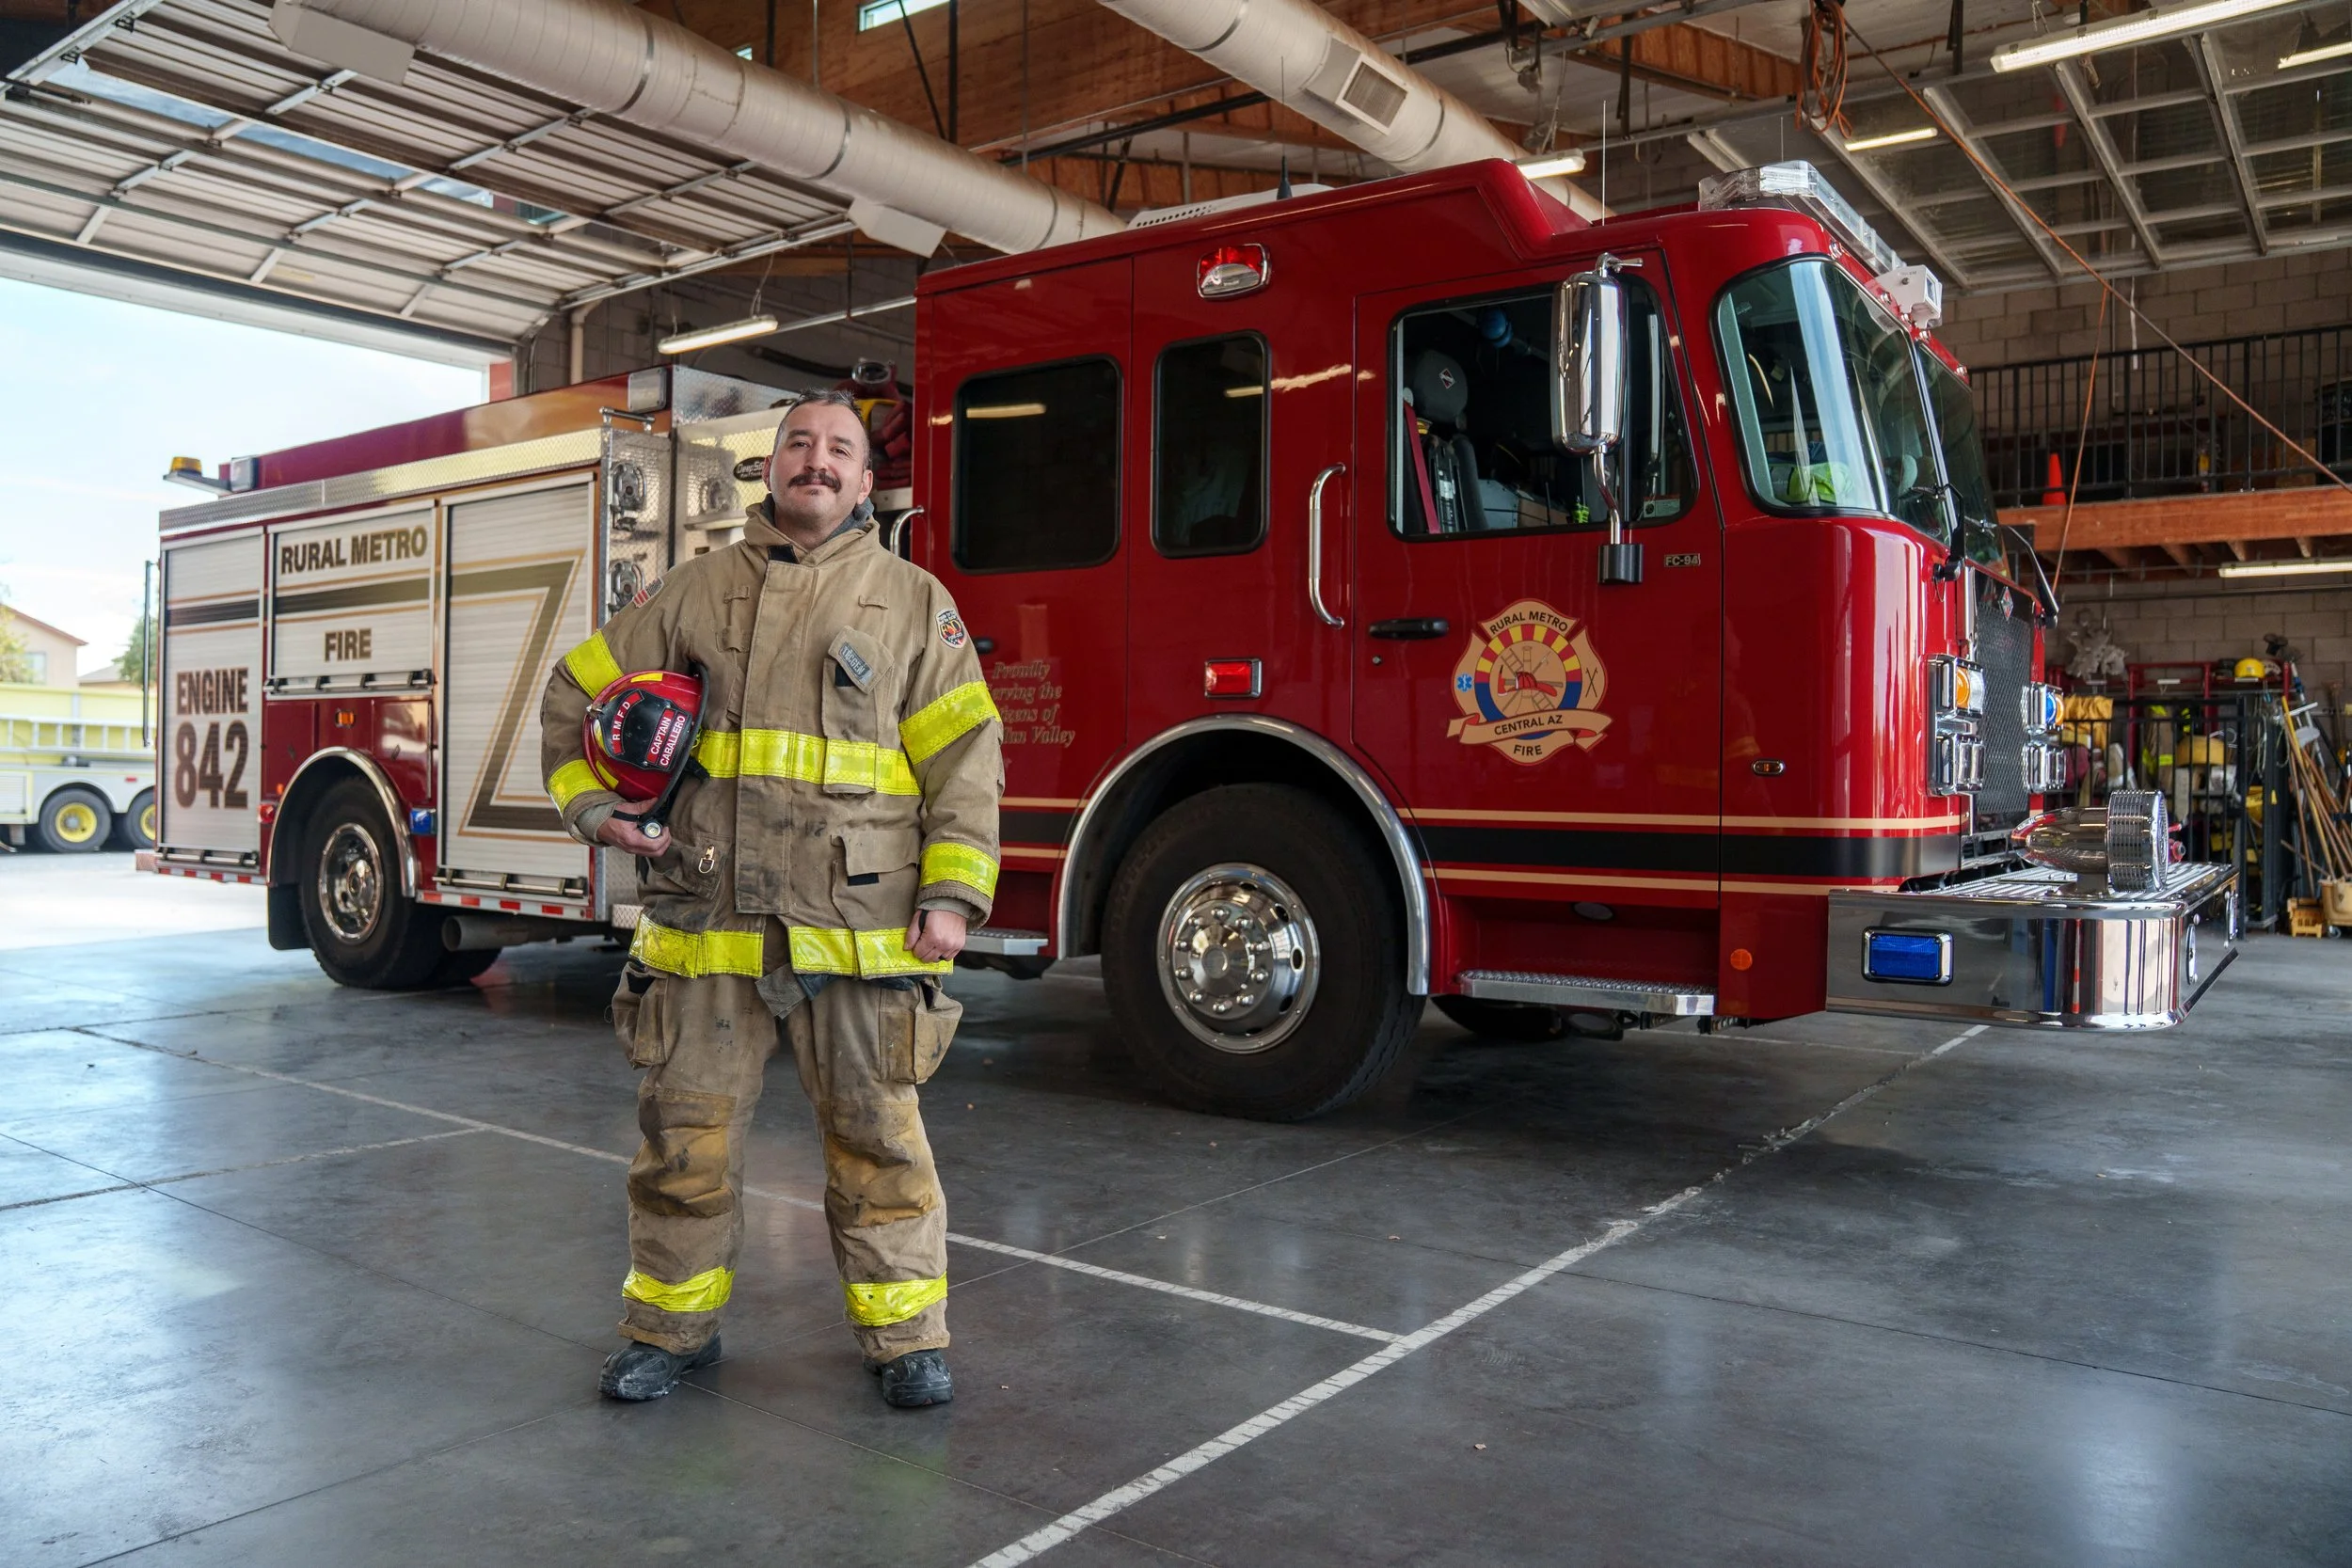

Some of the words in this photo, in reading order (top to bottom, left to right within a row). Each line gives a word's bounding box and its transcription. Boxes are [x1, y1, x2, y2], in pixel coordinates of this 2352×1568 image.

[281, 537, 347, 575] RURAL
[351, 525, 428, 565] METRO
[1489, 611, 1526, 635] RURAL
[1528, 610, 1568, 632] METRO
[325, 627, 373, 662] FIRE
[992, 659, 1051, 682] Proudly
[176, 667, 249, 716] ENGINE
[988, 683, 1037, 705] erving
[1038, 681, 1063, 700] the
[1041, 703, 1061, 726] of
[1494, 717, 1545, 736] CENTRAL
[1547, 715, 1564, 725] AZ
[650, 716, 672, 755] CAPTAIN
[660, 715, 686, 766] CABALLERO
[1031, 725, 1076, 749] Valley
[1513, 744, 1543, 756] FIRE
[175, 720, 249, 809] 842
